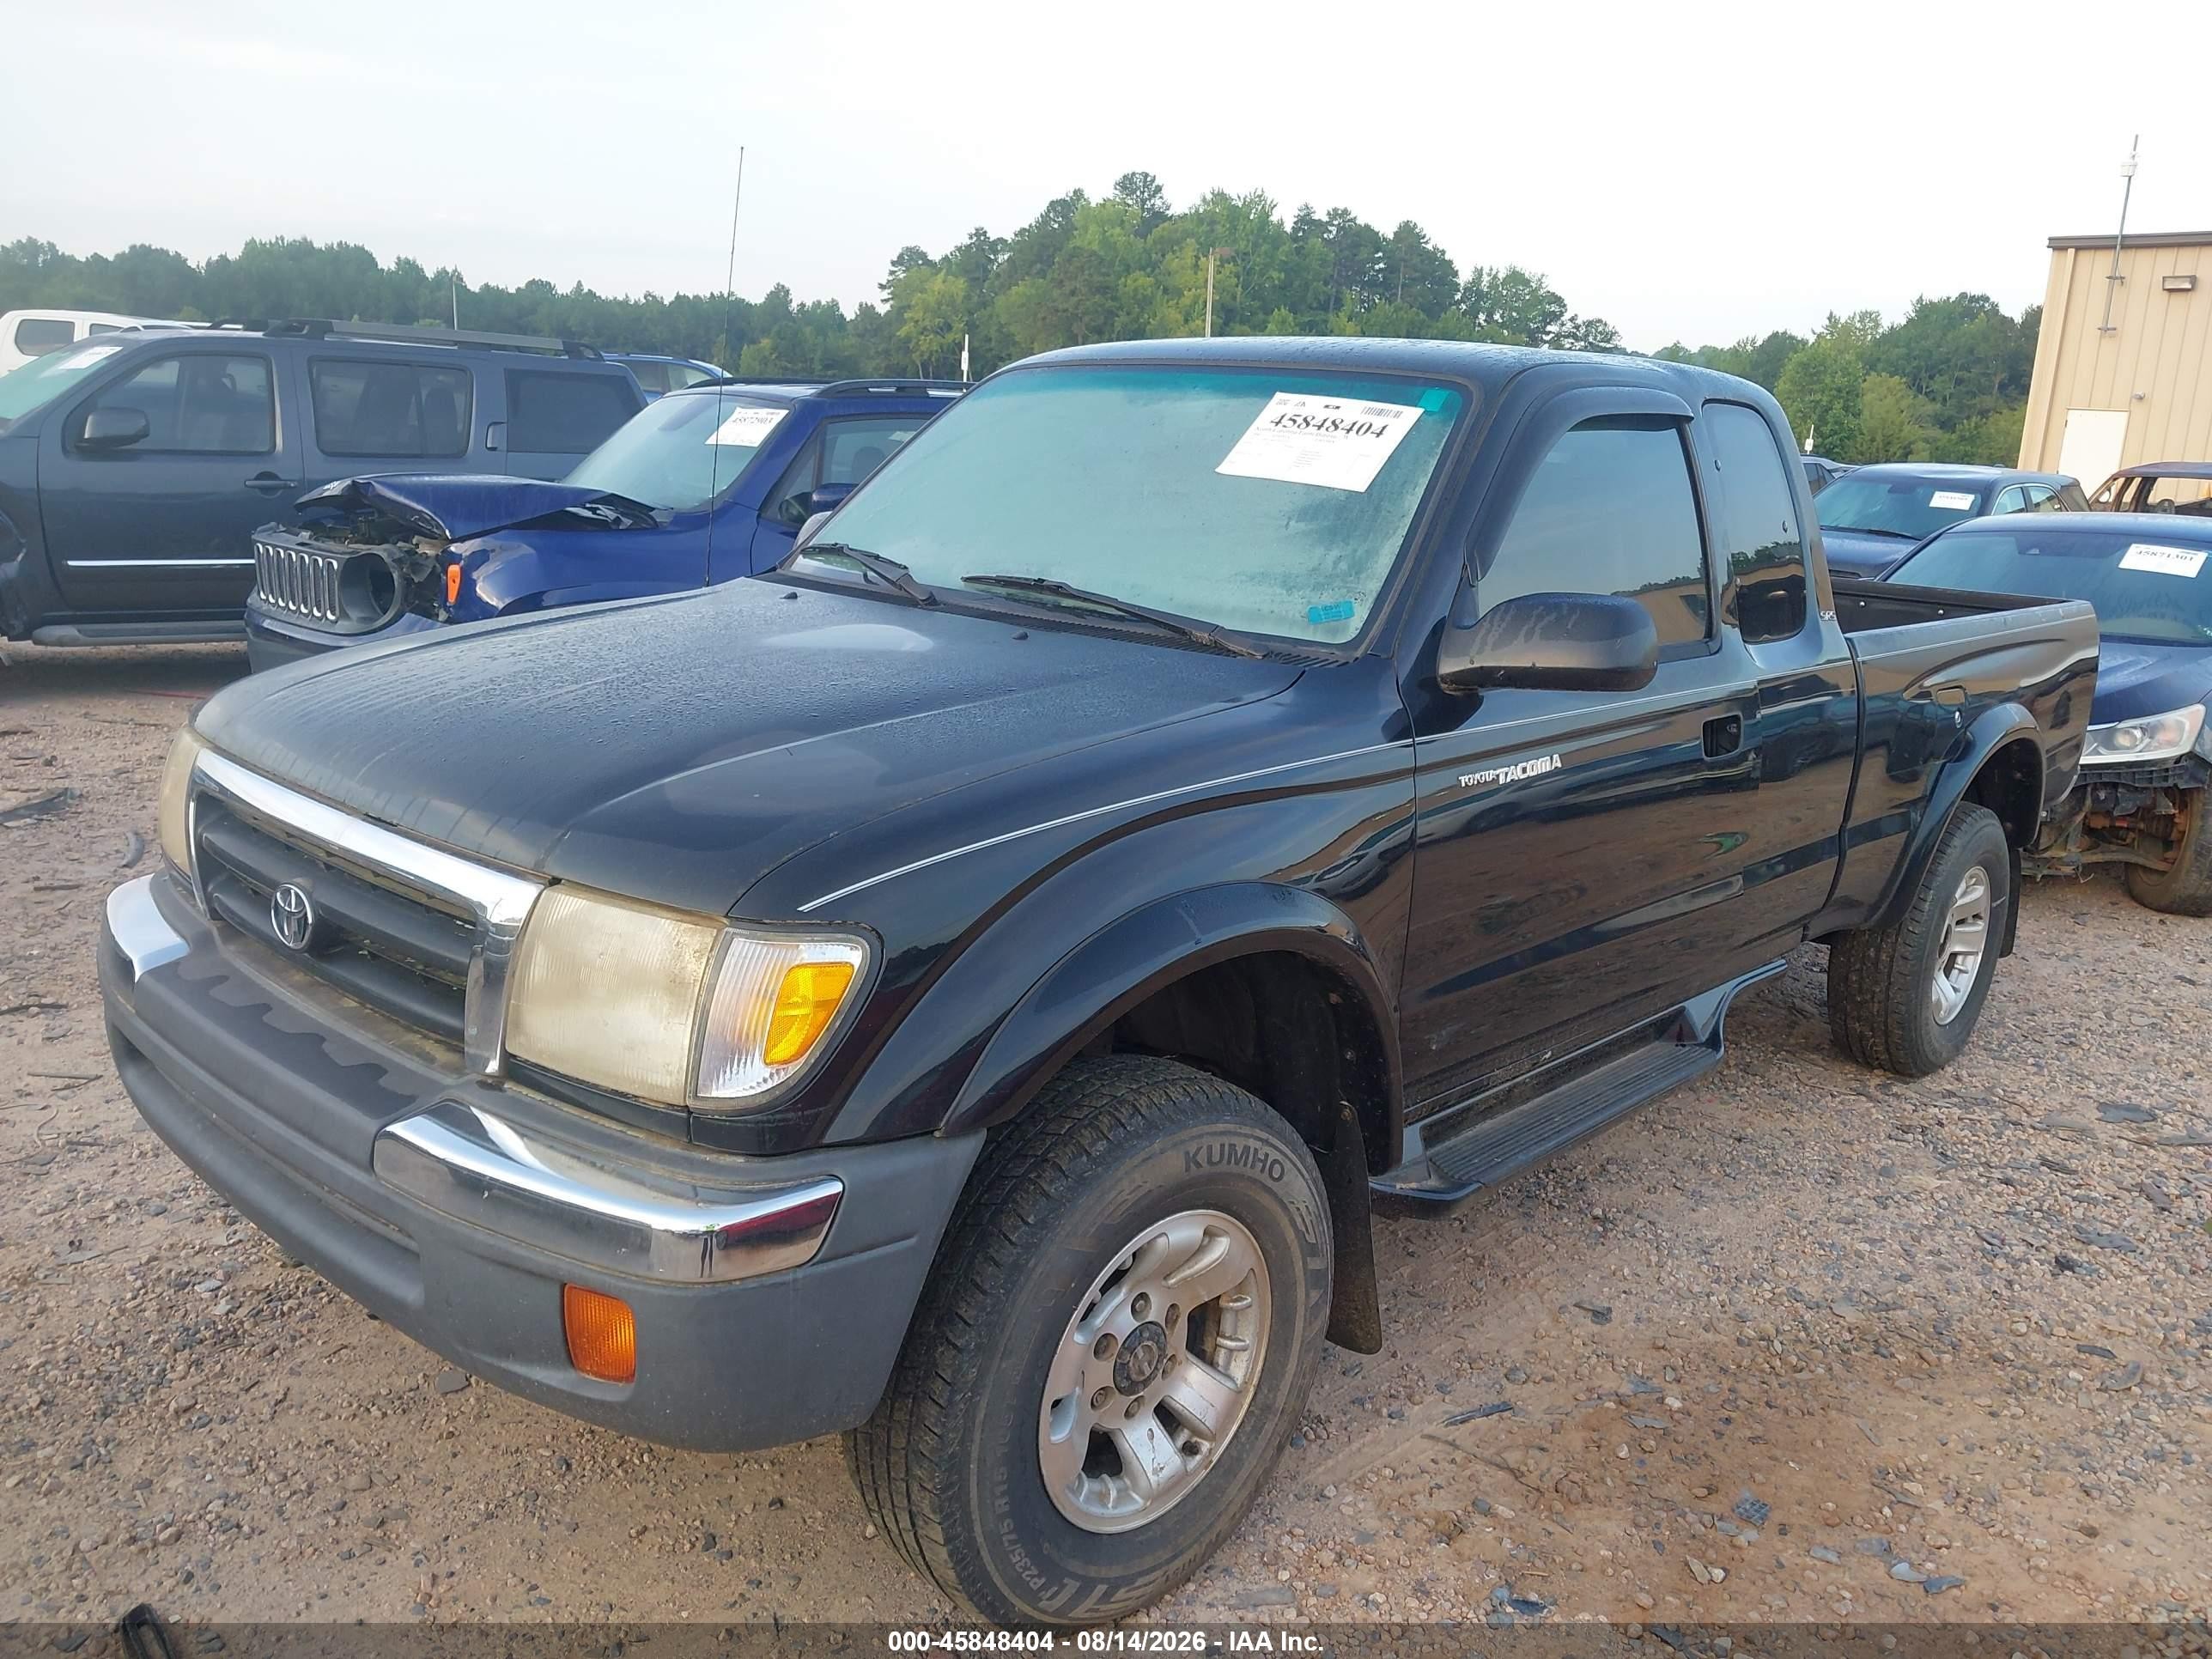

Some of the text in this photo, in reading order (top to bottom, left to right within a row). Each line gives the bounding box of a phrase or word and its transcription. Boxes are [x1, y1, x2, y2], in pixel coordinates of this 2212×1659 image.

[1270, 412, 1389, 439] 45848404
[1458, 753, 1563, 788] TOYOTA TACOMA
[1183, 1143, 1285, 1183] KUMHO
